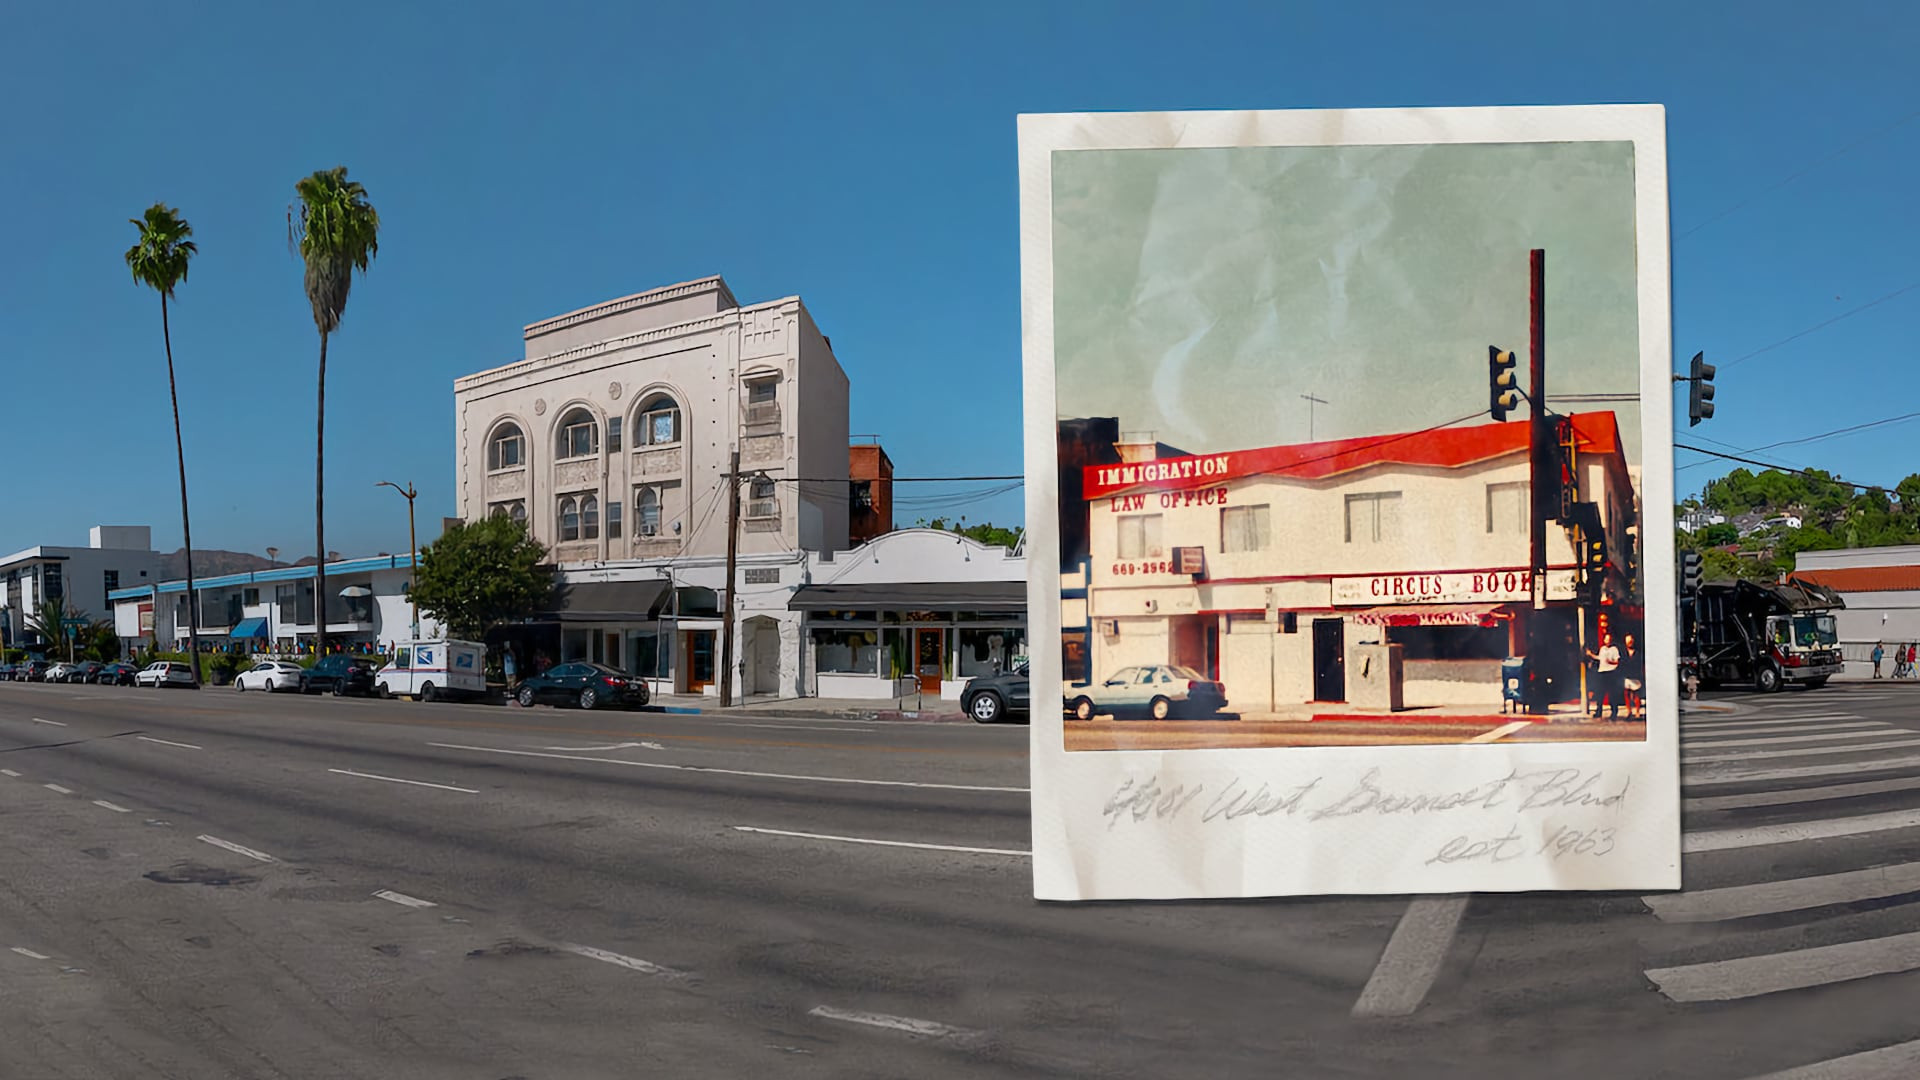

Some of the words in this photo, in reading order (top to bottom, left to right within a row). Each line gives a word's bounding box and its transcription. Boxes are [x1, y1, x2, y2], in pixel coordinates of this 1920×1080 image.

[1098, 456, 1230, 486] IMMIGRATION
[1110, 493, 1146, 513] LAW
[1160, 487, 1228, 509] OFFICE
[1371, 575, 1443, 597] CIRCUS
[1202, 776, 1322, 823] West
[1308, 767, 1517, 823] Sunset
[1517, 768, 1631, 815] Blvd
[1424, 823, 1526, 865] est
[1535, 824, 1617, 861] 1963
